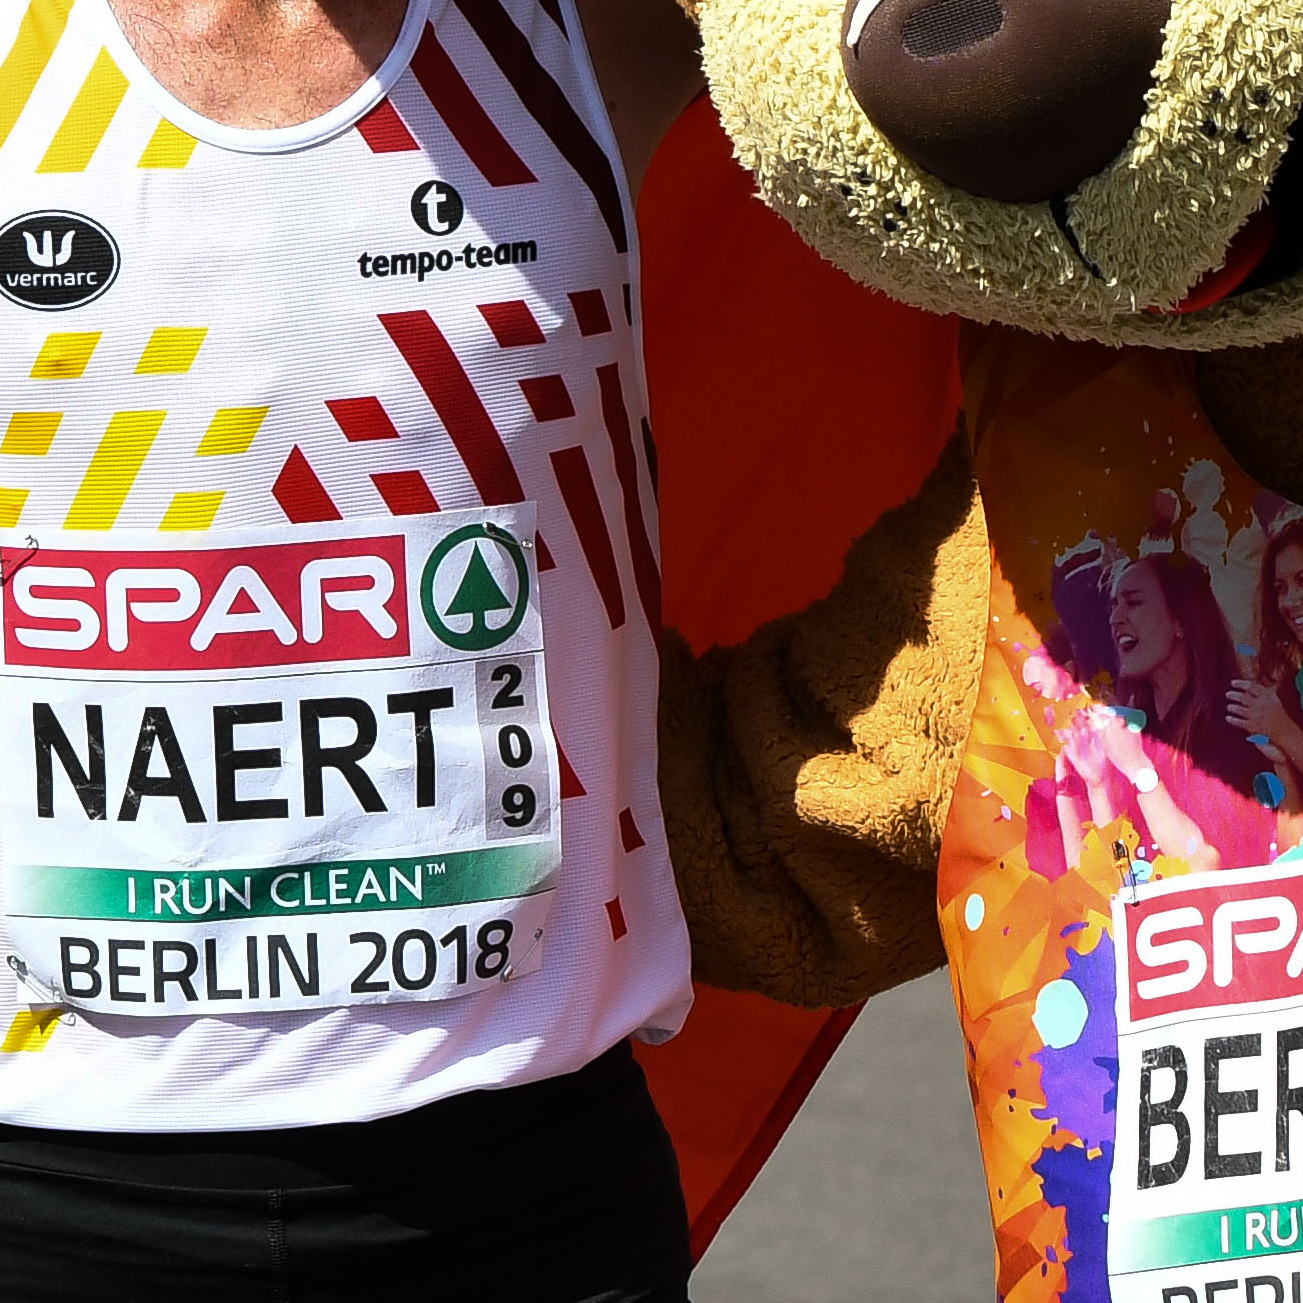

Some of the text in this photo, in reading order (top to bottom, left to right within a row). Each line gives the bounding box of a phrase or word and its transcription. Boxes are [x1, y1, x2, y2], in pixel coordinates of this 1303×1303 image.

[5, 271, 98, 287] vermarc
[357, 240, 538, 282] tempo-team
[12, 554, 399, 653] SPAR
[31, 686, 455, 825] NAERT
[127, 876, 137, 914] I
[153, 875, 252, 915] RUN
[59, 919, 515, 1004] BERLIN 2018
[1219, 1215, 1231, 1254] I
